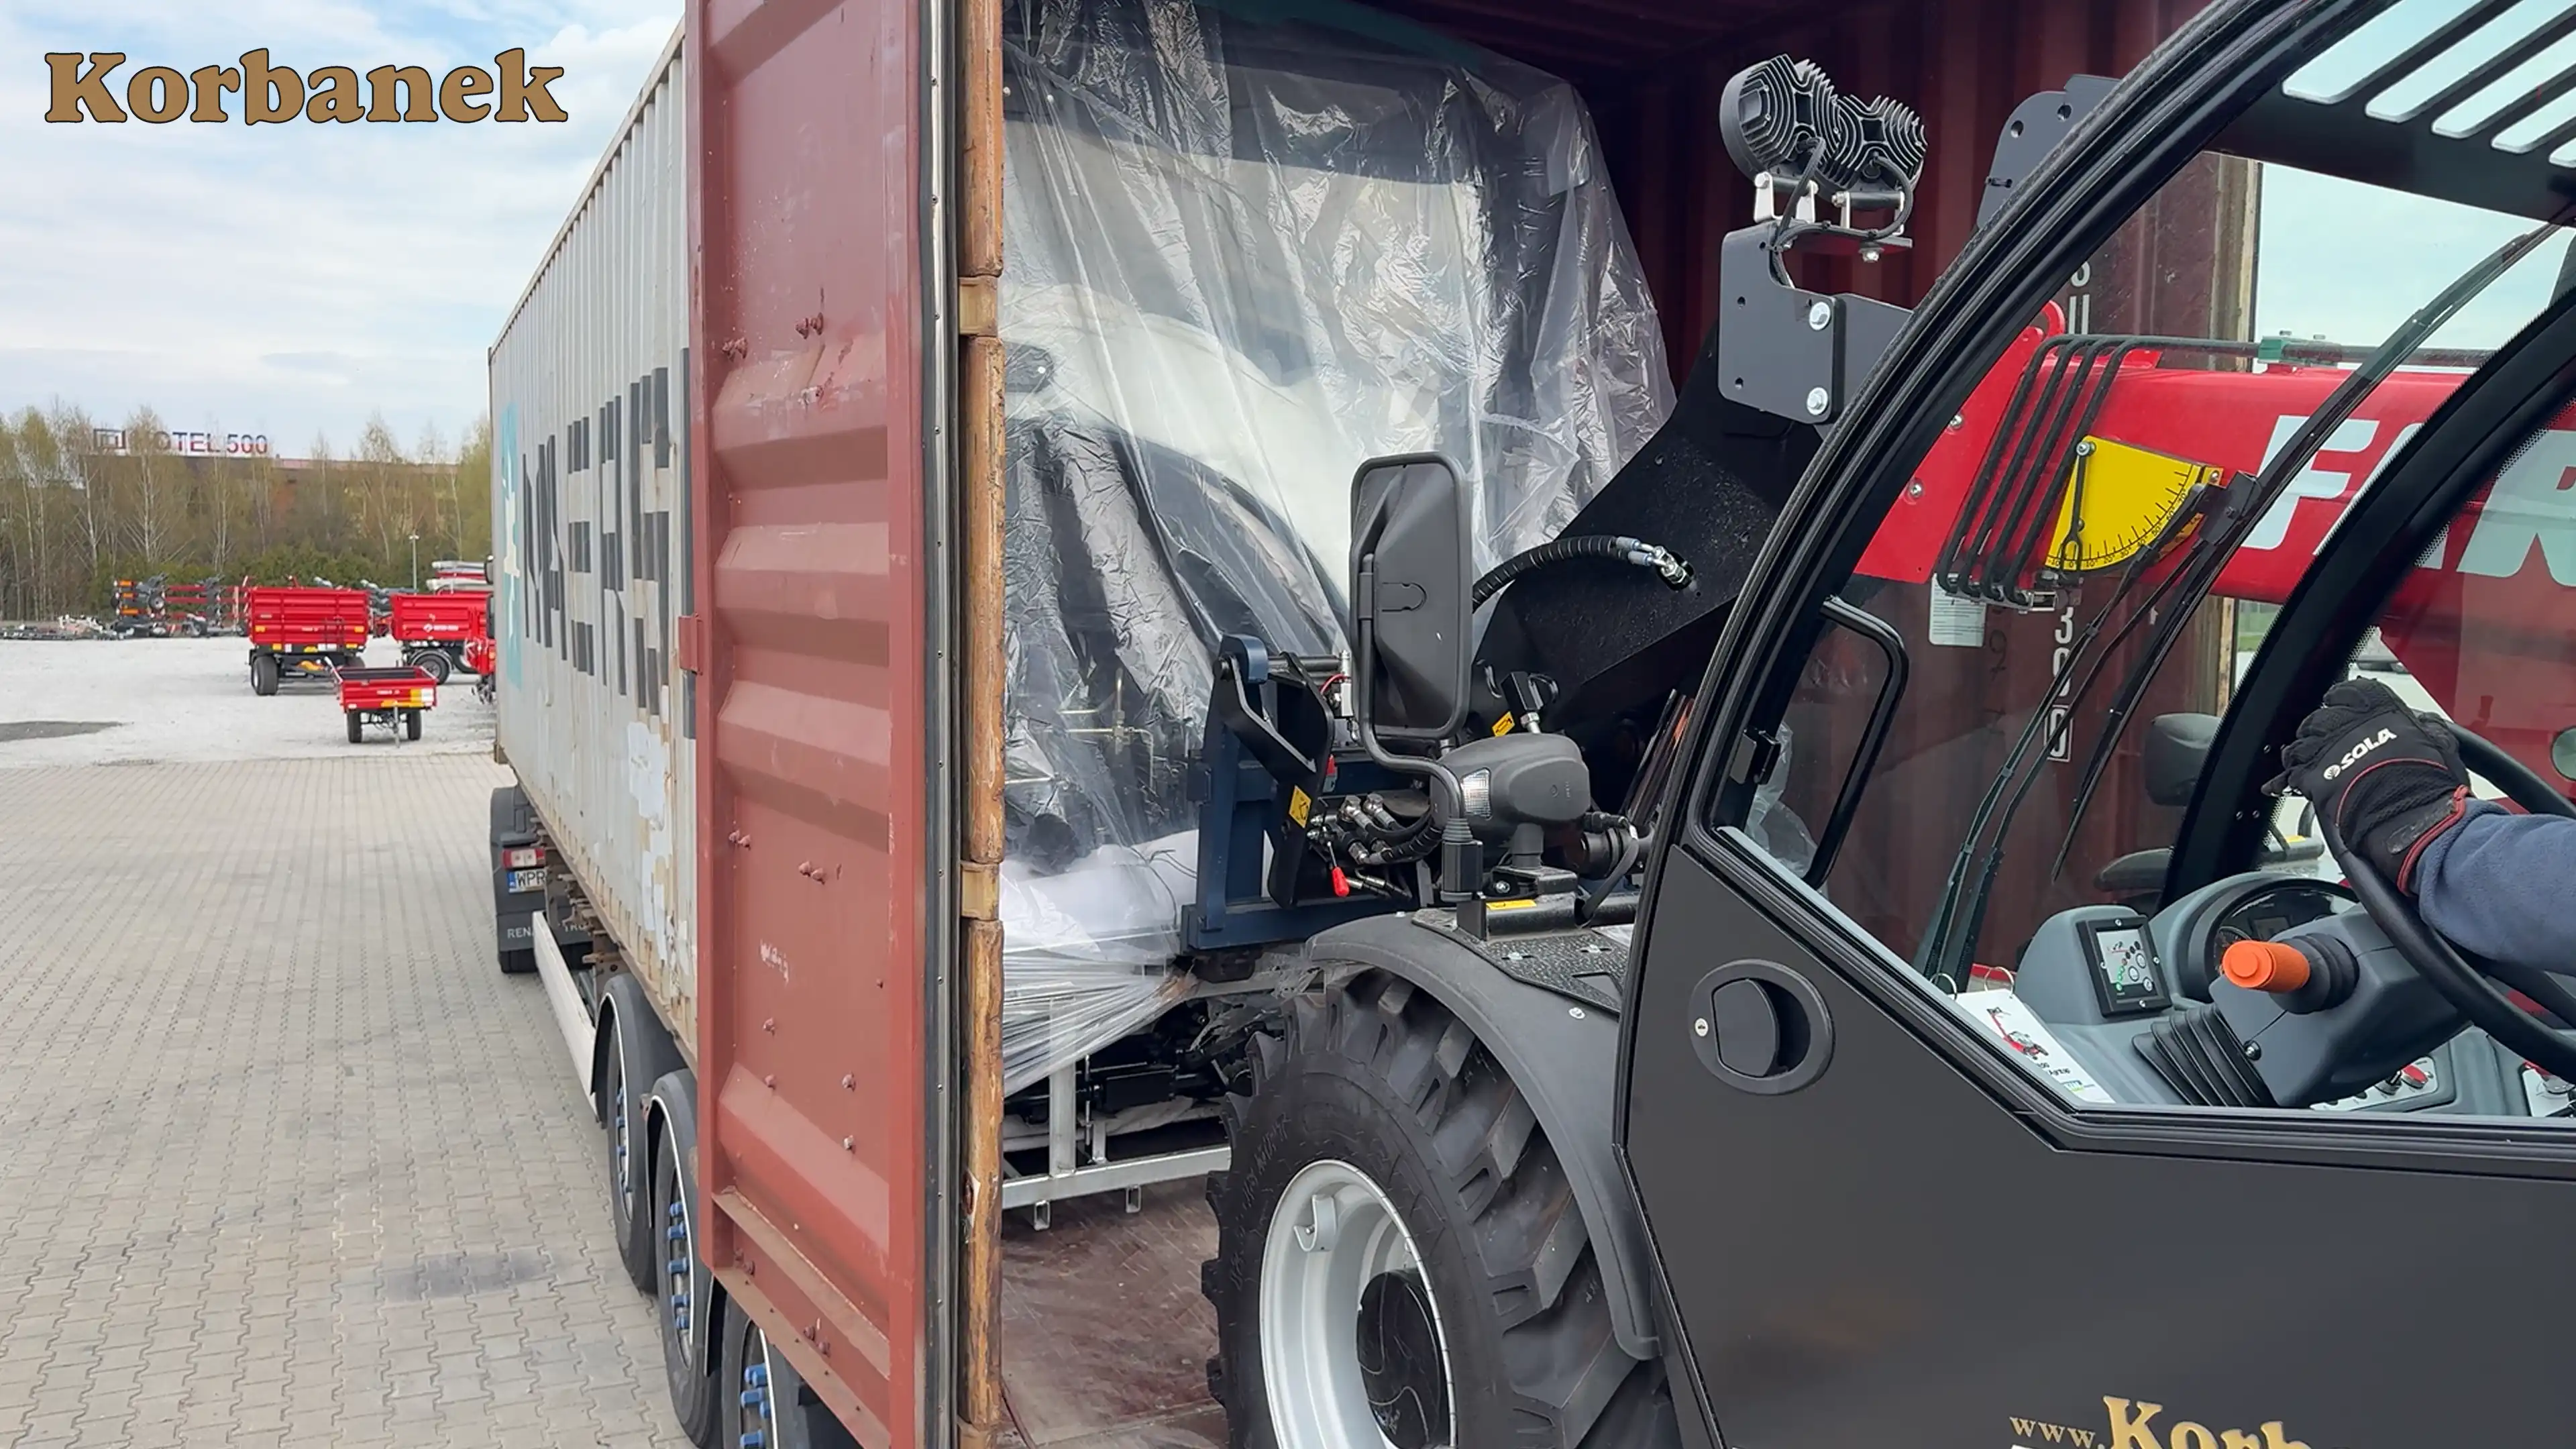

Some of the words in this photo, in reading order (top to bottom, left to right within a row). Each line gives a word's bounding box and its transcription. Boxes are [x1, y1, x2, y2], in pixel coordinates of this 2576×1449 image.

[136, 431, 221, 452] OTEL
[227, 435, 268, 453] 500
[2239, 414, 2576, 587] FR
[2340, 727, 2397, 770] SOLA
[507, 926, 534, 938] REN
